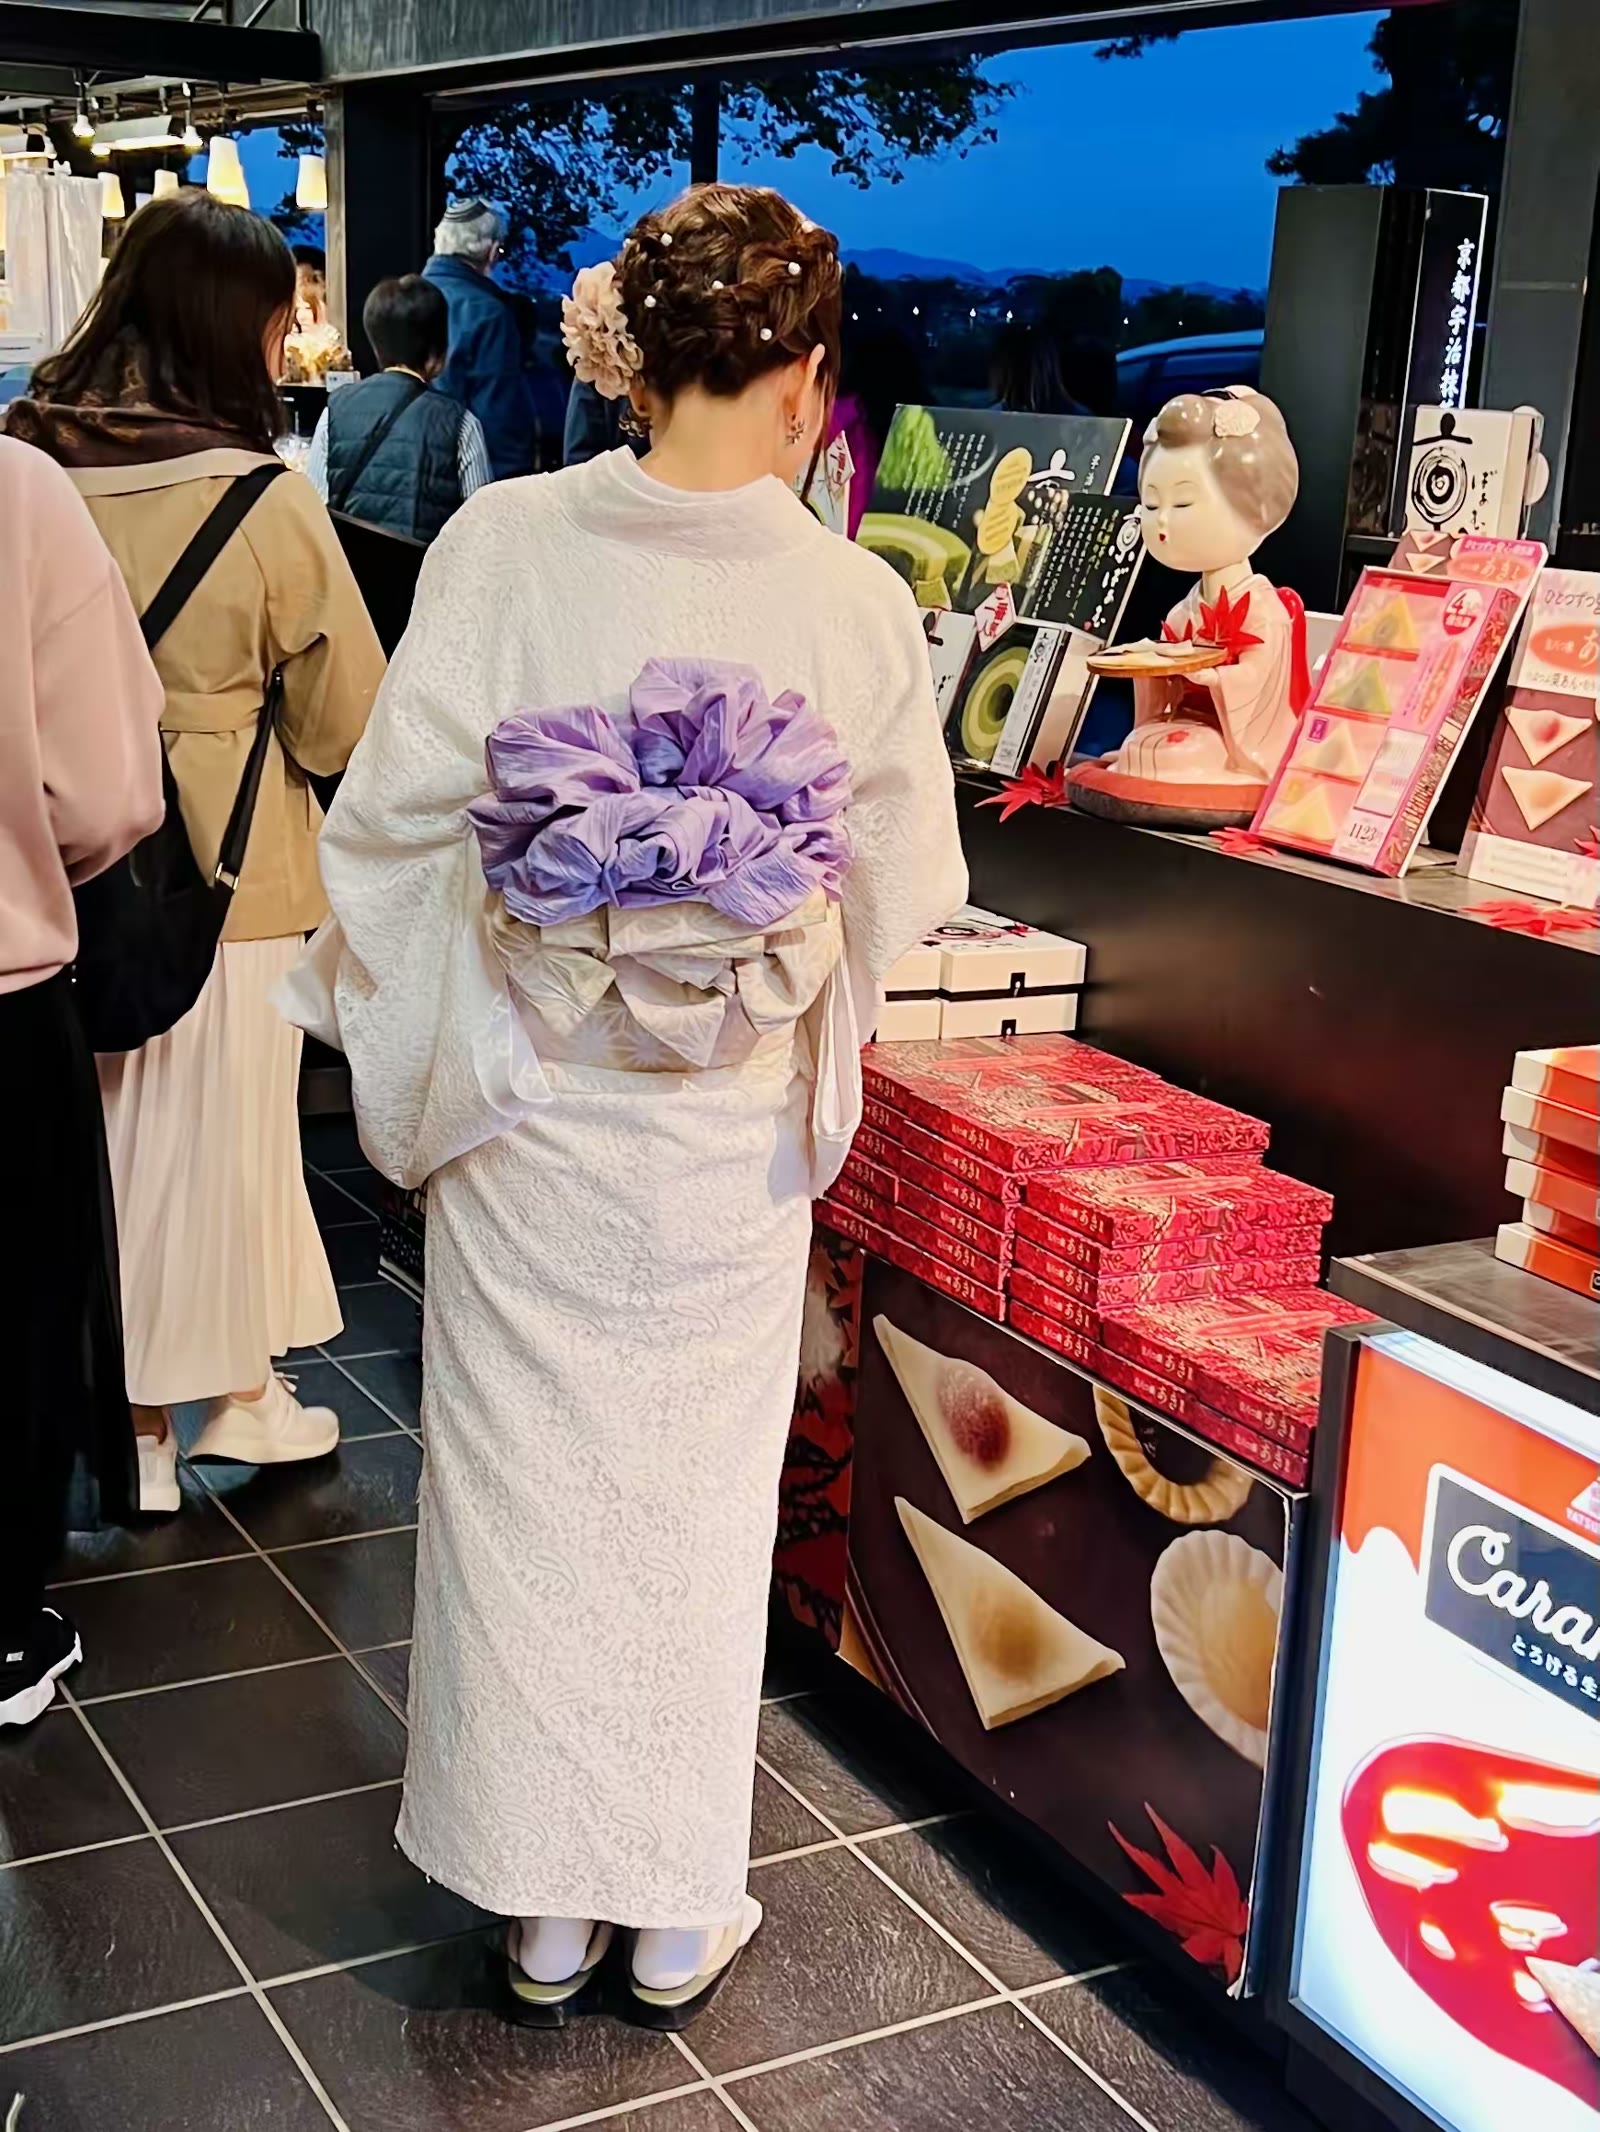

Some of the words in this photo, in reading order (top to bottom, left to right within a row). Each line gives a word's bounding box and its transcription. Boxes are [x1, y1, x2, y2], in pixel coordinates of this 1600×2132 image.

[1439, 238, 1475, 408] 京都宇治抹
[1511, 1634, 1600, 1700] とろける生
